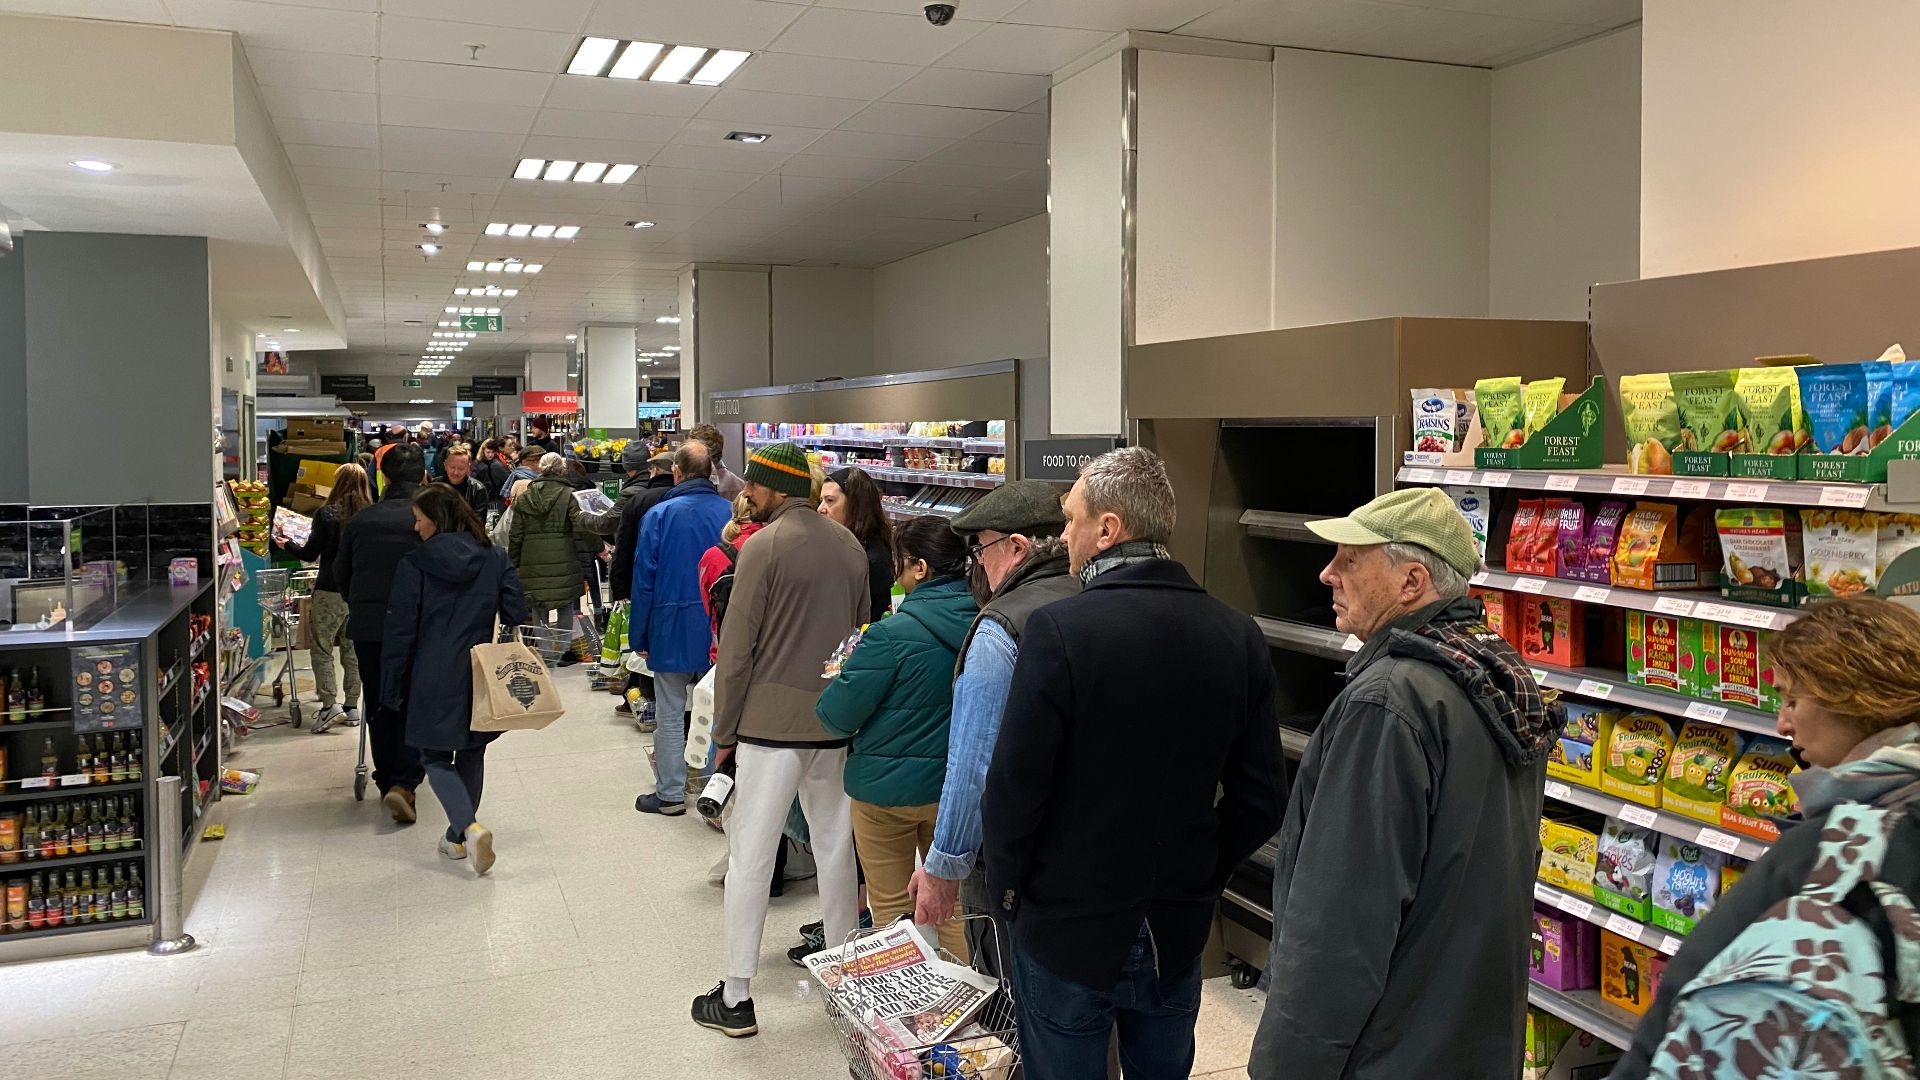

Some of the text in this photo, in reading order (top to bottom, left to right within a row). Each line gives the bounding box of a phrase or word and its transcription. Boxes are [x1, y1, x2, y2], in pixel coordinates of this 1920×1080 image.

[1685, 387, 1725, 396] FOREST
[1743, 385, 1779, 394] FOREST
[1809, 382, 1852, 392] FOREST
[544, 395, 577, 403] OFFERS
[1482, 393, 1512, 401] FOREST
[1630, 391, 1668, 400] FOREST
[1689, 396, 1720, 404] FEAST
[1745, 395, 1775, 403] FEAST
[1811, 392, 1848, 402] FEAST
[714, 400, 727, 415] FOOD
[1633, 401, 1666, 409] FEAST
[1544, 436, 1580, 446] FOREST
[1548, 447, 1577, 456] FEAST
[1043, 455, 1064, 467] FOOD
[1066, 455, 1077, 467] TO
[1684, 457, 1712, 465] FOREST
[1744, 460, 1774, 468] FOREST
[1812, 461, 1847, 470] FOREST
[1688, 464, 1711, 472] FEAST
[1747, 468, 1773, 476] FEAST
[1816, 469, 1845, 478] FEAST
[1560, 508, 1580, 519] URBAN
[1599, 506, 1622, 518] URBAN
[1635, 510, 1663, 521] URBAN
[1515, 517, 1533, 527] FRUIT
[1559, 520, 1580, 531] FRUIT
[1594, 517, 1615, 527] FRUIT
[1632, 519, 1659, 532] FRUIT
[1541, 615, 1552, 623] BEAR
[1653, 643, 1669, 652] SOUR
[1648, 649, 1675, 662] RAISIN
[1652, 660, 1670, 670] SNACKS
[1730, 656, 1748, 666] SOUR
[1724, 662, 1754, 677] RAISIN
[1729, 674, 1750, 685] SNACKS
[1629, 719, 1663, 736] Sunny
[1686, 725, 1728, 746] Sunny
[1722, 812, 1739, 823] REAL
[1738, 816, 1758, 828] FRUIT
[1673, 868, 1706, 891] yogurt
[809, 939, 884, 968] Daily Mail
[875, 957, 890, 967] this
[889, 949, 917, 962] Sunday
[1623, 960, 1637, 971] BEAR
[834, 962, 933, 999] SCHOOL'S OUT,
[845, 983, 896, 1010] EXAMS
[852, 991, 910, 1019] DEATHS
[910, 975, 948, 999] SOAR
[873, 1001, 903, 1018] AND
[903, 990, 942, 1011] ARMY
[940, 977, 957, 991] IN
